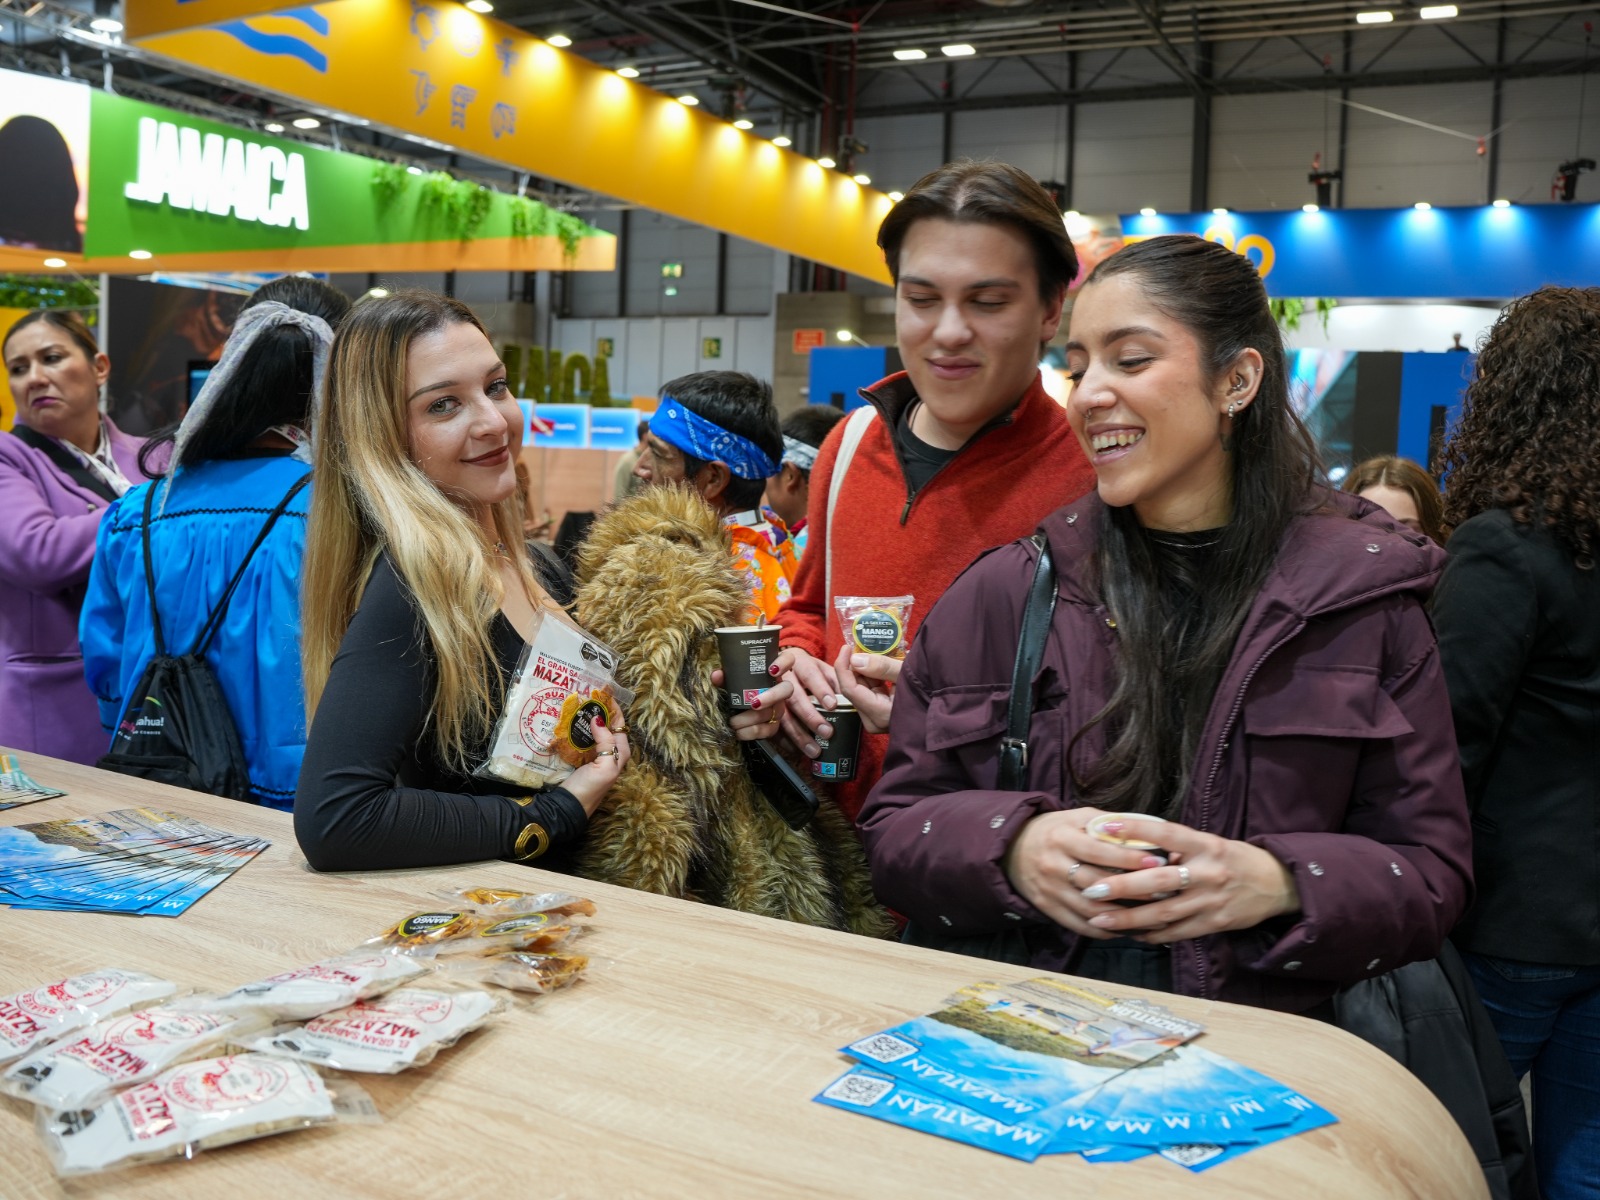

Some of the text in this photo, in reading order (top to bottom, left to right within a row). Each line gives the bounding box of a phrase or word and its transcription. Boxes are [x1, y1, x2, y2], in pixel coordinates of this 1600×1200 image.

[124, 116, 310, 231] JAMAICA
[861, 628, 895, 636] MANGO
[537, 656, 547, 666] EL
[547, 662, 568, 674] GRAN
[412, 917, 452, 925] MANGO
[361, 1035, 395, 1048] GRAN
[902, 1058, 1034, 1114] MAZATLÁN
[887, 1094, 1043, 1146] MAZATLÁN
